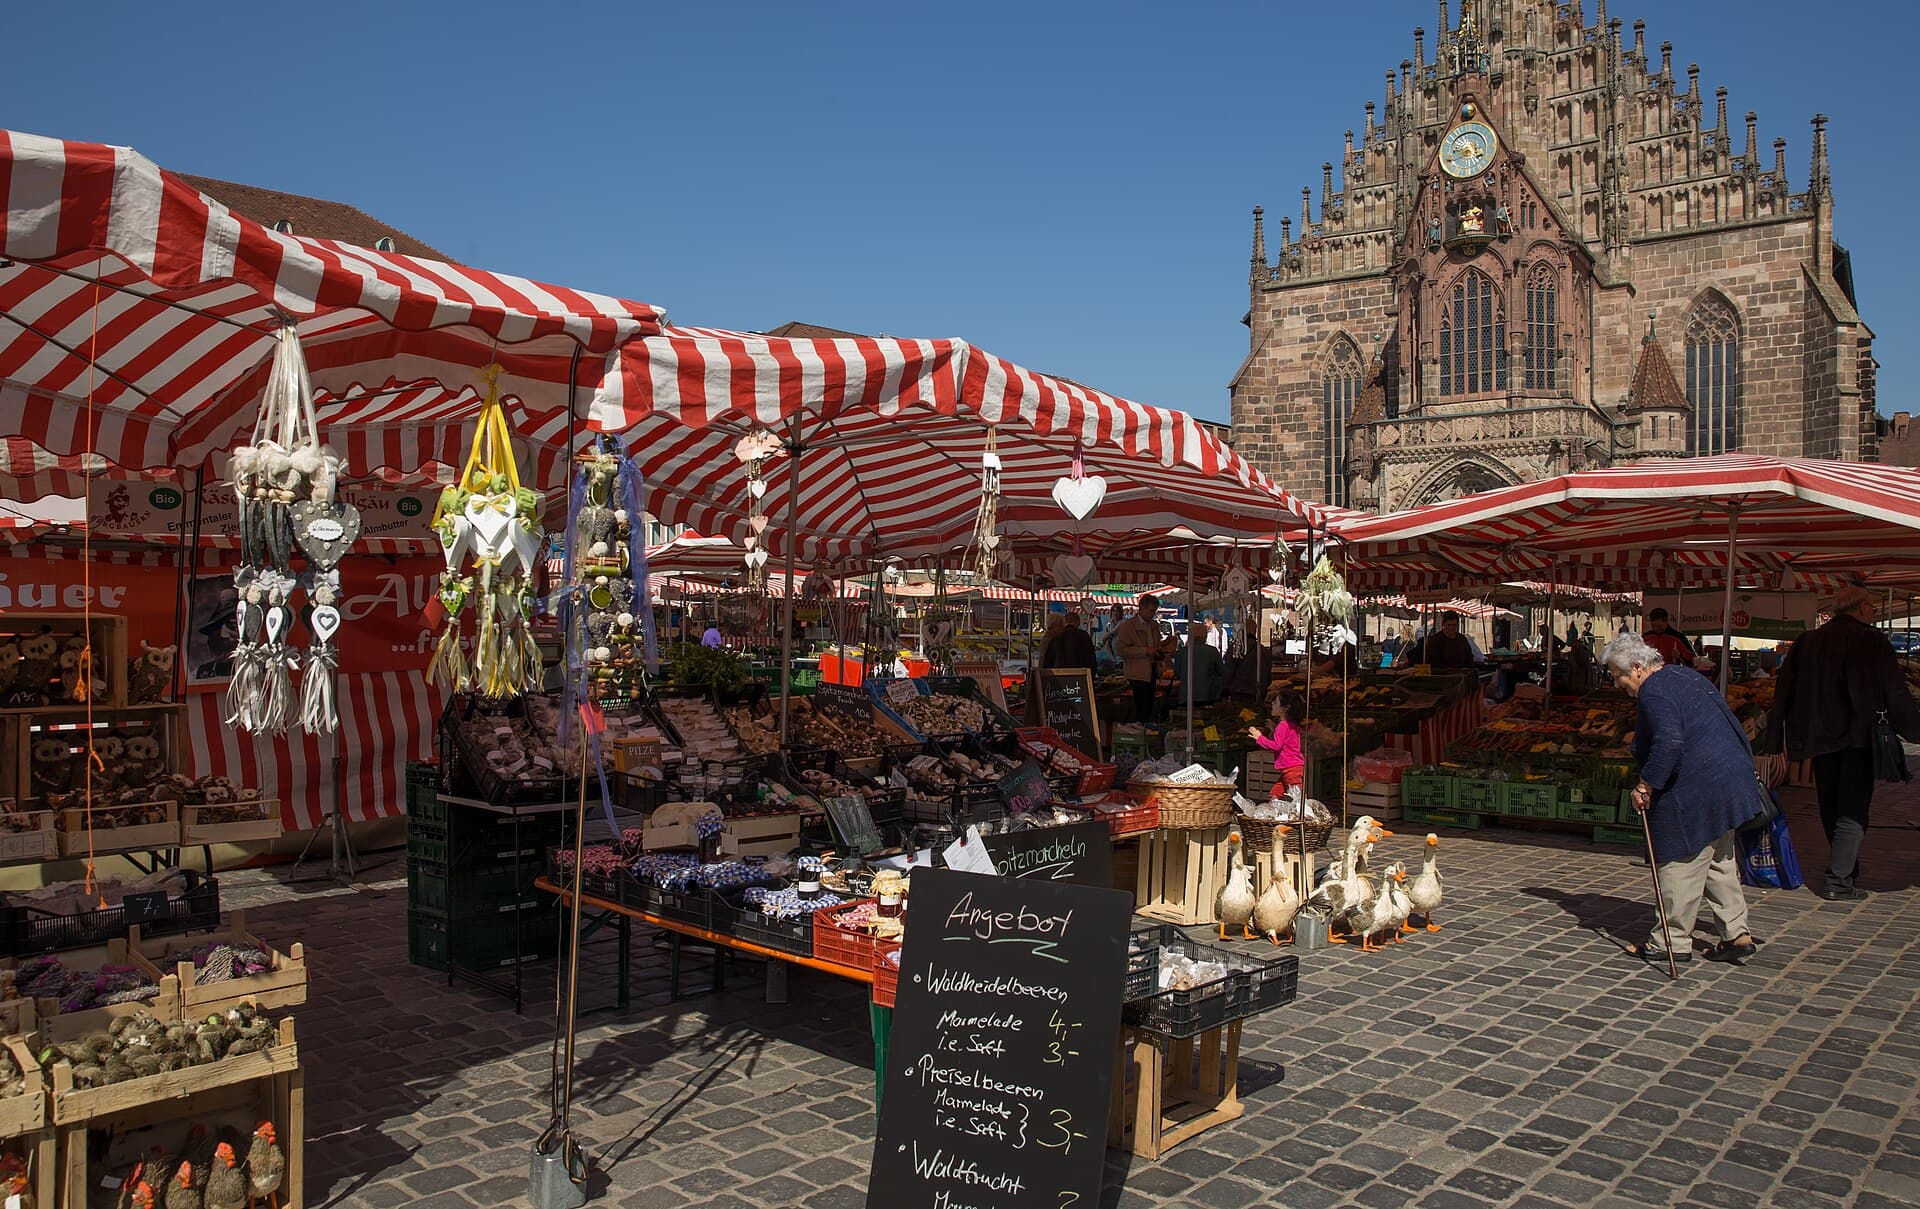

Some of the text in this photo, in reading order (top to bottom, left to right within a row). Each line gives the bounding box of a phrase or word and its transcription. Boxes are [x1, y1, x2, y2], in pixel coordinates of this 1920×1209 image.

[155, 494, 175, 504] Bio
[401, 502, 417, 511] Bio
[364, 519, 409, 536] Almbutter
[628, 745, 656, 757] PILZE
[945, 891, 1073, 939] Angebot
[927, 962, 1068, 1004] Waldheidelbeeren
[935, 1009, 1024, 1031] Marmelade
[966, 1034, 1008, 1059] Saft
[918, 1053, 1044, 1100] Preiselbeeren
[933, 1087, 1012, 1120] Marmelade
[965, 1116, 1007, 1141] Saft
[913, 1139, 1027, 1195] Waldfrucht
